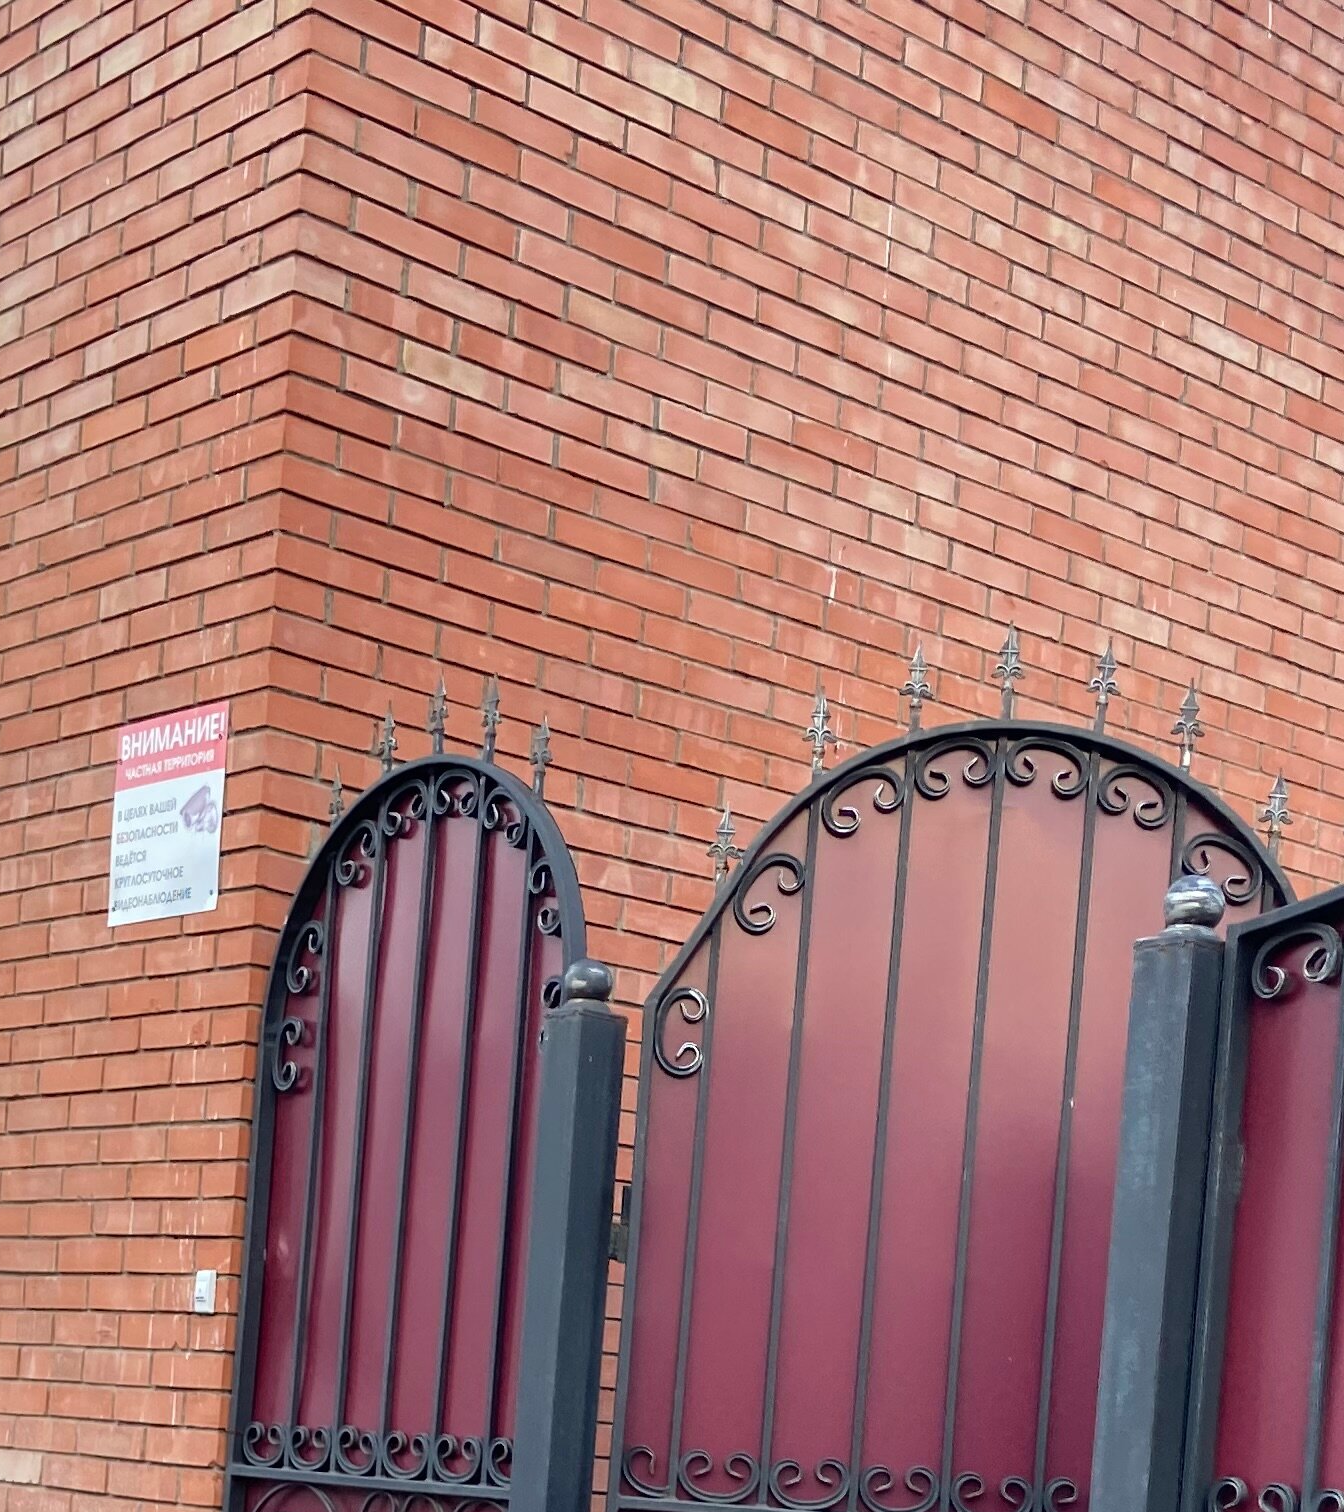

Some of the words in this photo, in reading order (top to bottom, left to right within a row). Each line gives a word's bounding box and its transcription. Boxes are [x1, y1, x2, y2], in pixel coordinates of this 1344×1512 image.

[121, 711, 225, 762] ВНИМАНИЕ!
[125, 759, 163, 780] ЧАСТНАЯ
[163, 748, 215, 774] ТЕРРИТОРИЯ
[123, 804, 148, 822] ЦЕЛЯХ
[149, 797, 177, 816] ВАШЕЙ
[116, 821, 179, 844] БЕЗОПАСНОСТИ
[114, 865, 184, 889] КРУГЛОСУТОЧНОЕ
[114, 887, 192, 912] ВИДЕОНАБЛЮДЕНИЕ
